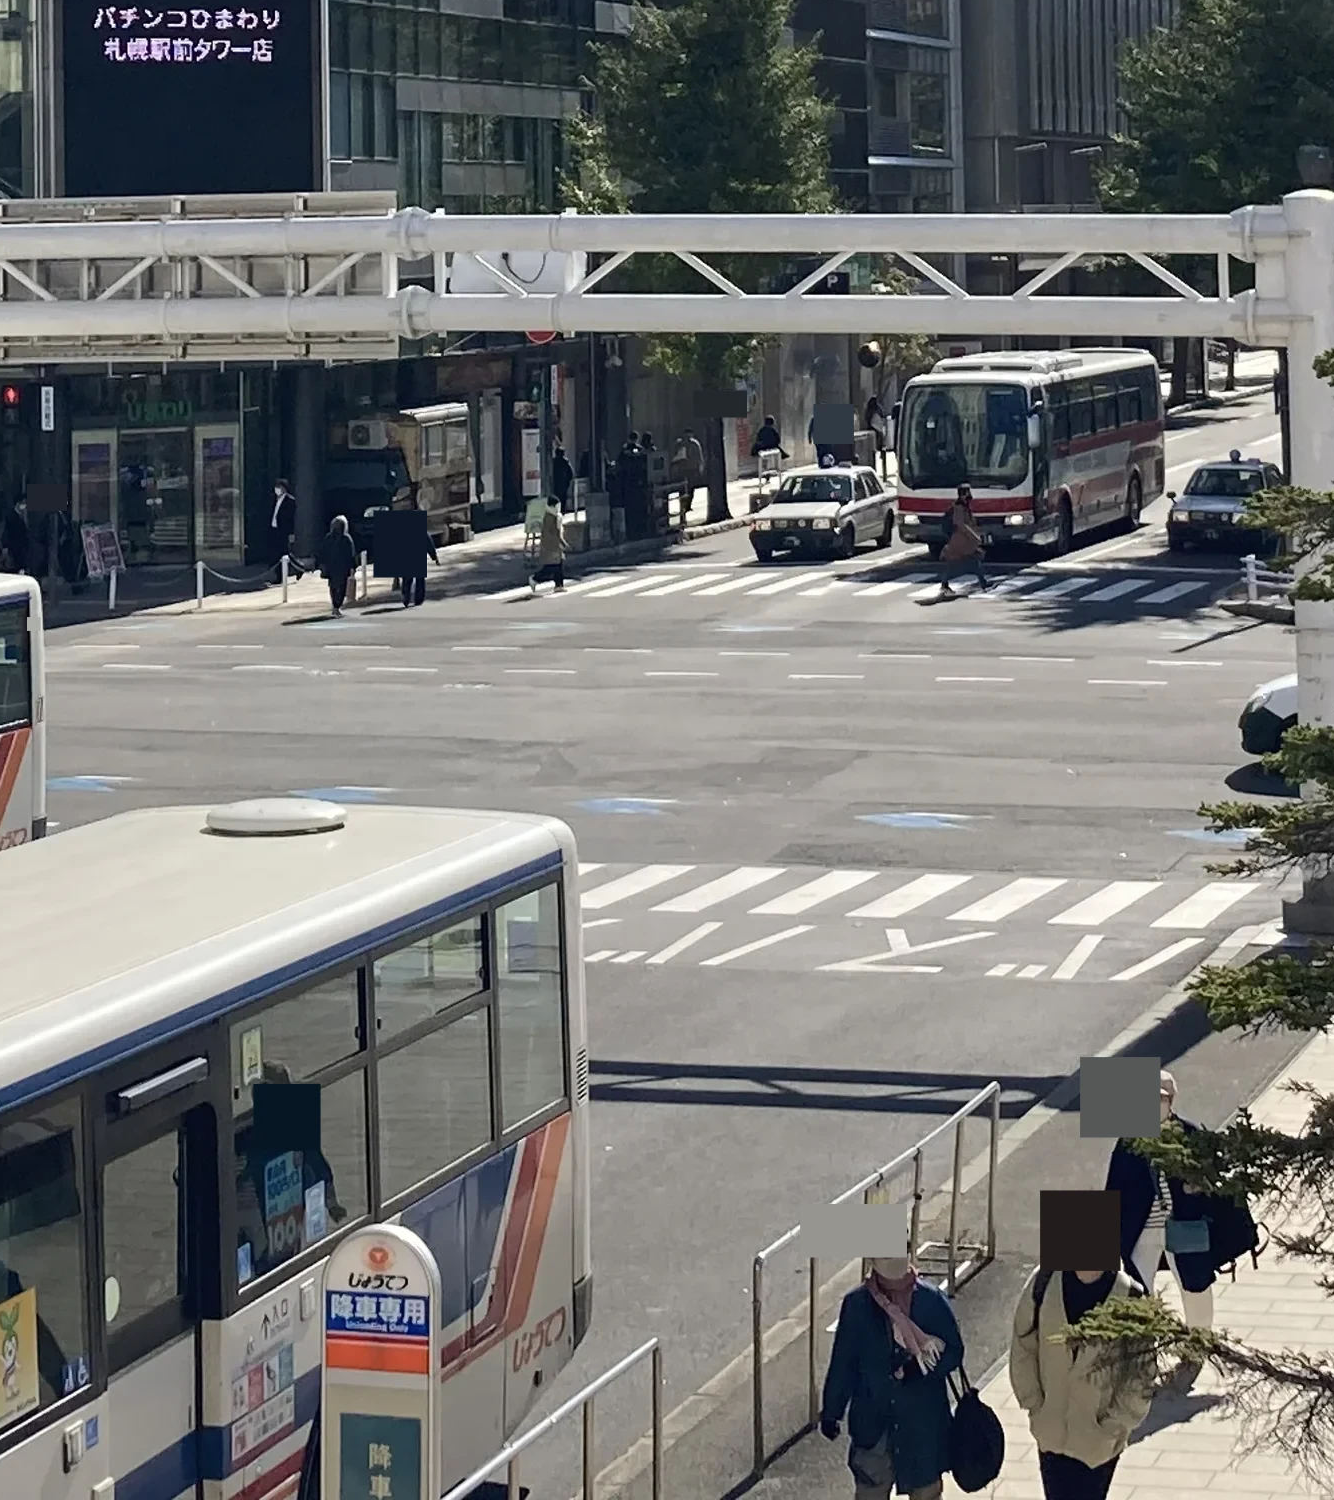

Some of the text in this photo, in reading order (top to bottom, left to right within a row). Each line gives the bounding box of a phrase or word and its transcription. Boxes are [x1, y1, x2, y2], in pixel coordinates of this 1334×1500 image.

[93, 6, 281, 30] パチンコひまわり
[103, 36, 274, 63] 札幌駅前タワー店
[348, 1271, 409, 1292] じょうてつ
[330, 1292, 427, 1325] 降車専用
[511, 1305, 568, 1374] じょうてつ
[367, 1442, 393, 1500] 降車
